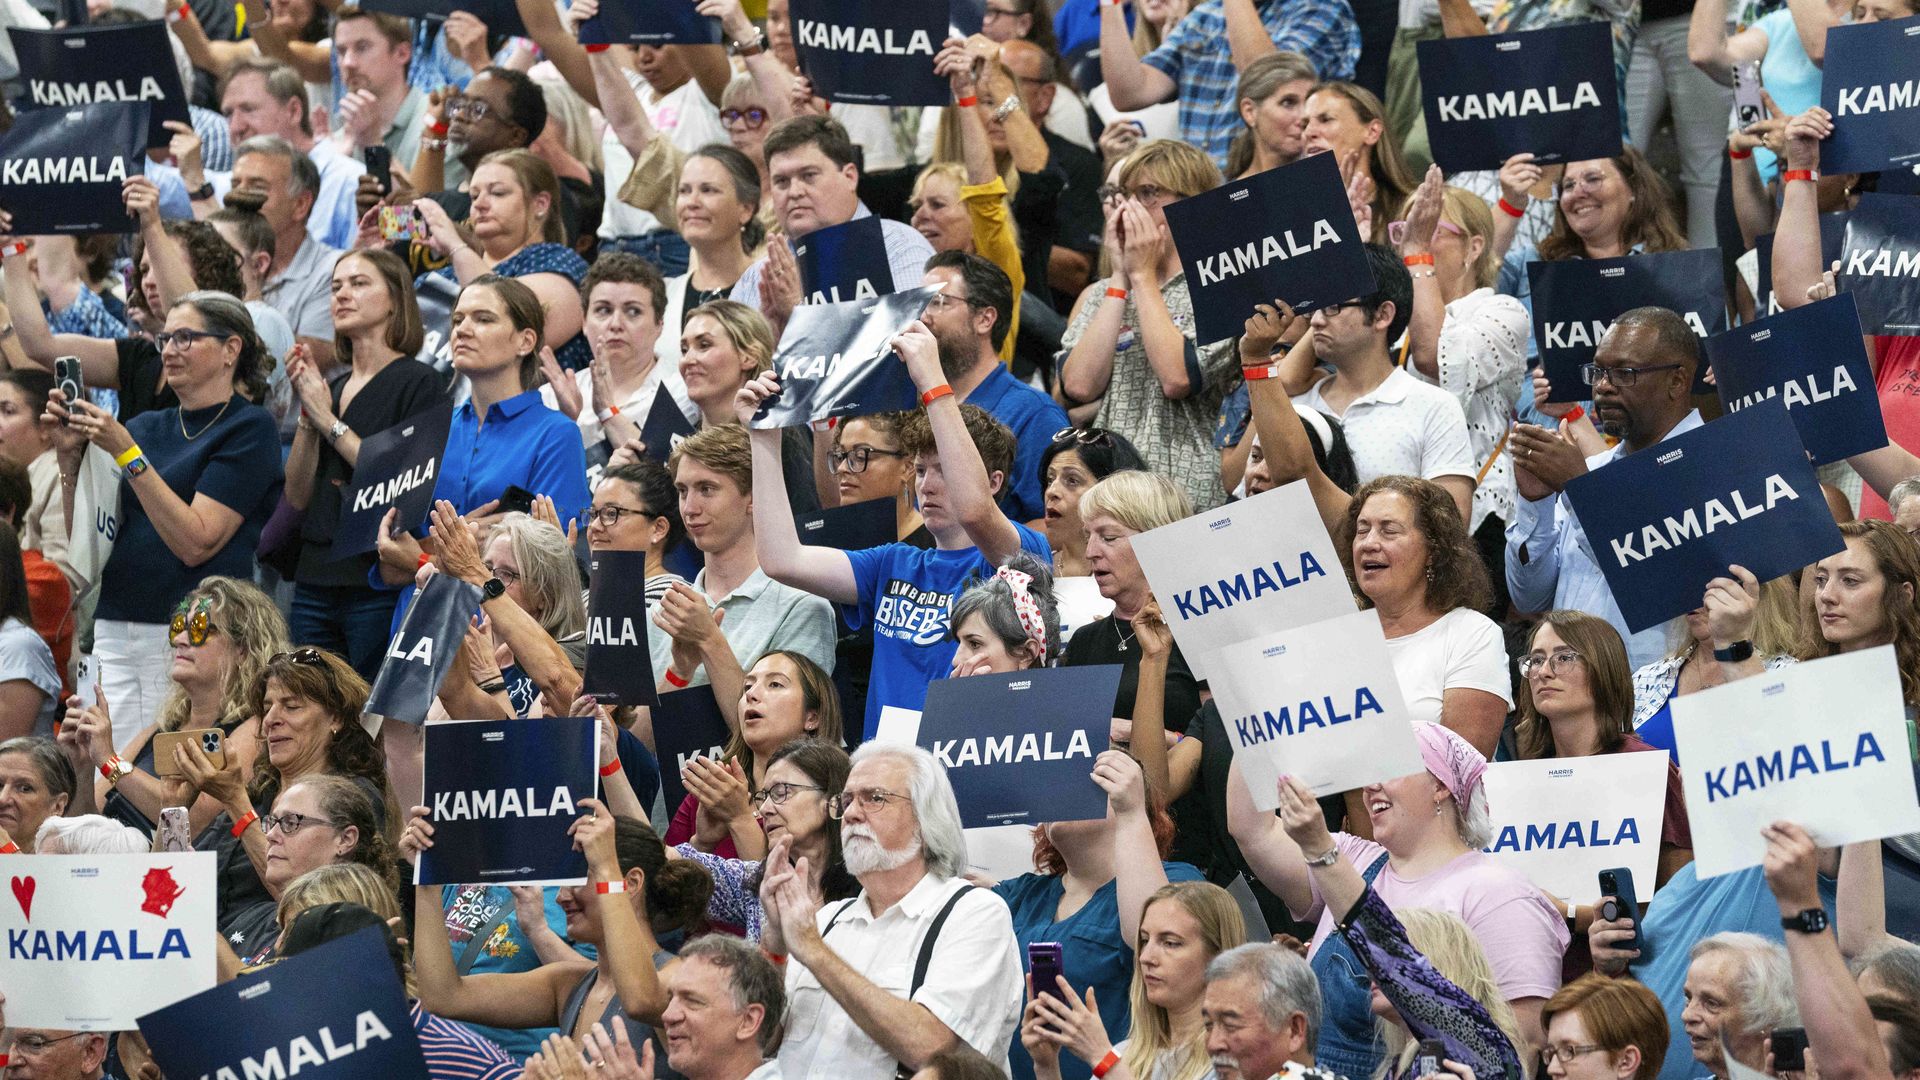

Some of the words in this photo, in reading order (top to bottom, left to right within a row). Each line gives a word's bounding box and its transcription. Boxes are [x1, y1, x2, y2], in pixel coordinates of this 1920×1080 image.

[797, 19, 934, 55] KAMALA
[30, 76, 165, 107] KAMALA
[1437, 81, 1601, 122] KAMALA
[2, 156, 127, 185] KAMALA
[1195, 218, 1342, 286] KAMALA
[1600, 266, 1625, 275] HARRIS
[1751, 329, 1771, 340] HARRIS
[1657, 448, 1683, 463] HARRIS
[352, 457, 435, 512] KAMALA
[1209, 517, 1231, 528] HARRIS
[1610, 473, 1800, 568] KAMALA
[1173, 551, 1327, 620] KAMALA
[1263, 645, 1286, 655] HARRIS
[1008, 680, 1032, 688] HARRIS
[1234, 686, 1384, 748] KAMALA
[932, 729, 1092, 768] KAMALA
[1705, 732, 1886, 803] KAMALA
[433, 785, 576, 822] KAMALA
[1483, 818, 1641, 853] AMALA
[8, 928, 191, 961] KAMALA
